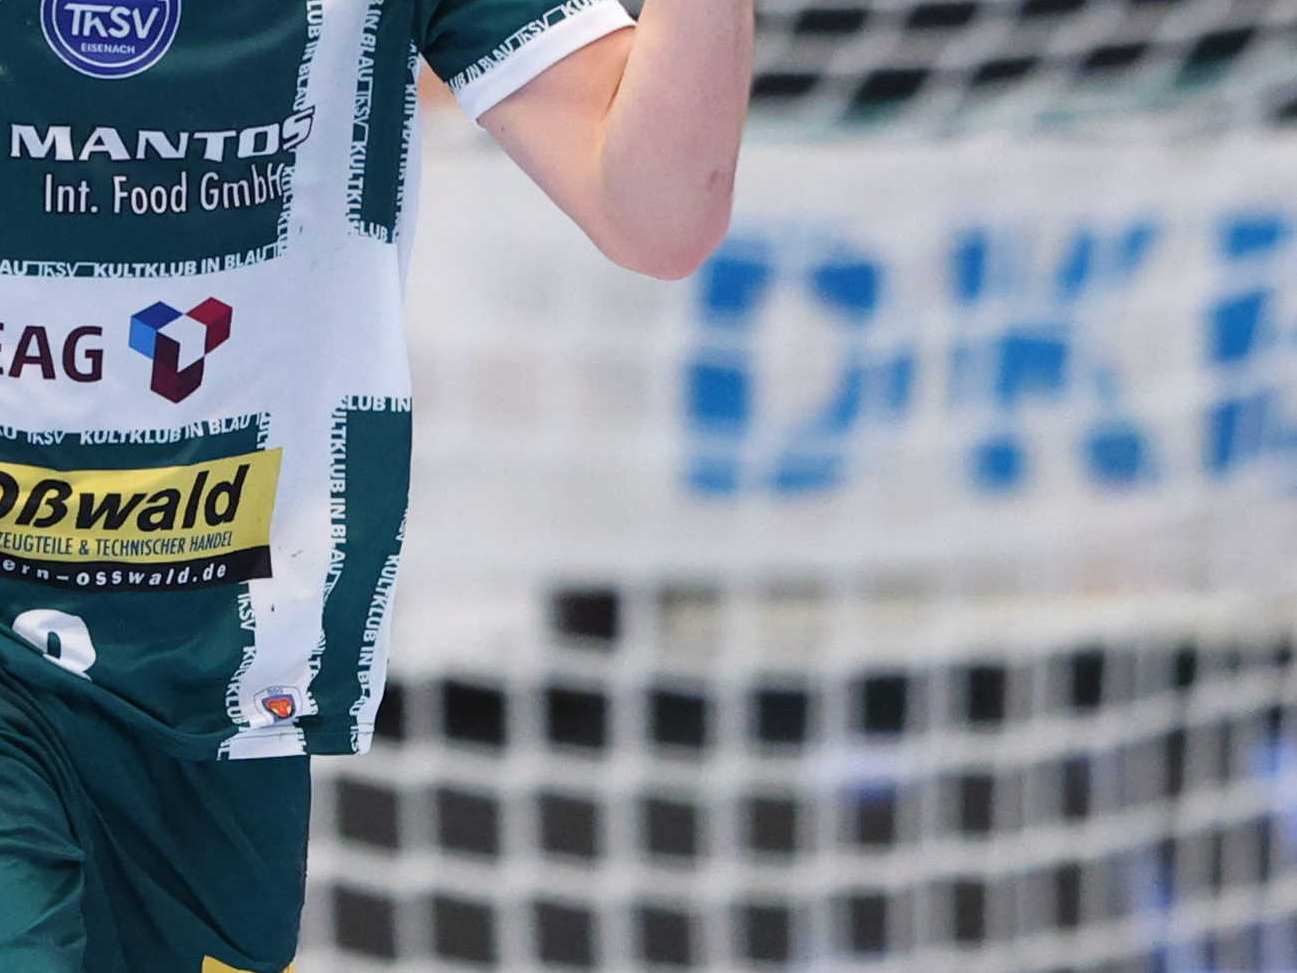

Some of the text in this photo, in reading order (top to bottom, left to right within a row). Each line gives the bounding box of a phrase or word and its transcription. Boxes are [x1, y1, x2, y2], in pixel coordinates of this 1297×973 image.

[365, 8, 382, 30] IN
[81, 42, 136, 55] EISENACH
[305, 42, 318, 61] IN
[357, 32, 376, 81] BLAU
[466, 63, 481, 82] IN
[477, 43, 515, 71] BLAU
[293, 64, 311, 112] BLAU
[10, 106, 315, 163] MANTOS
[44, 160, 285, 215] Int. Food GmbH
[93, 260, 198, 278] KULTKLUB
[201, 257, 221, 275] IN
[224, 246, 266, 271] BLAU
[390, 396, 411, 412] IN
[80, 429, 182, 446] KULTKLUB
[185, 421, 204, 440] IN
[209, 414, 251, 437] BLAU
[330, 498, 346, 521] IN
[79, 539, 90, 555] &
[95, 537, 185, 557] TECHNISCHER
[189, 530, 232, 552] HANDEL
[329, 525, 346, 577] BLAU
[362, 554, 400, 644] KULTKLUB
[358, 646, 374, 667] IN
[225, 645, 255, 724] KULTKLUB
